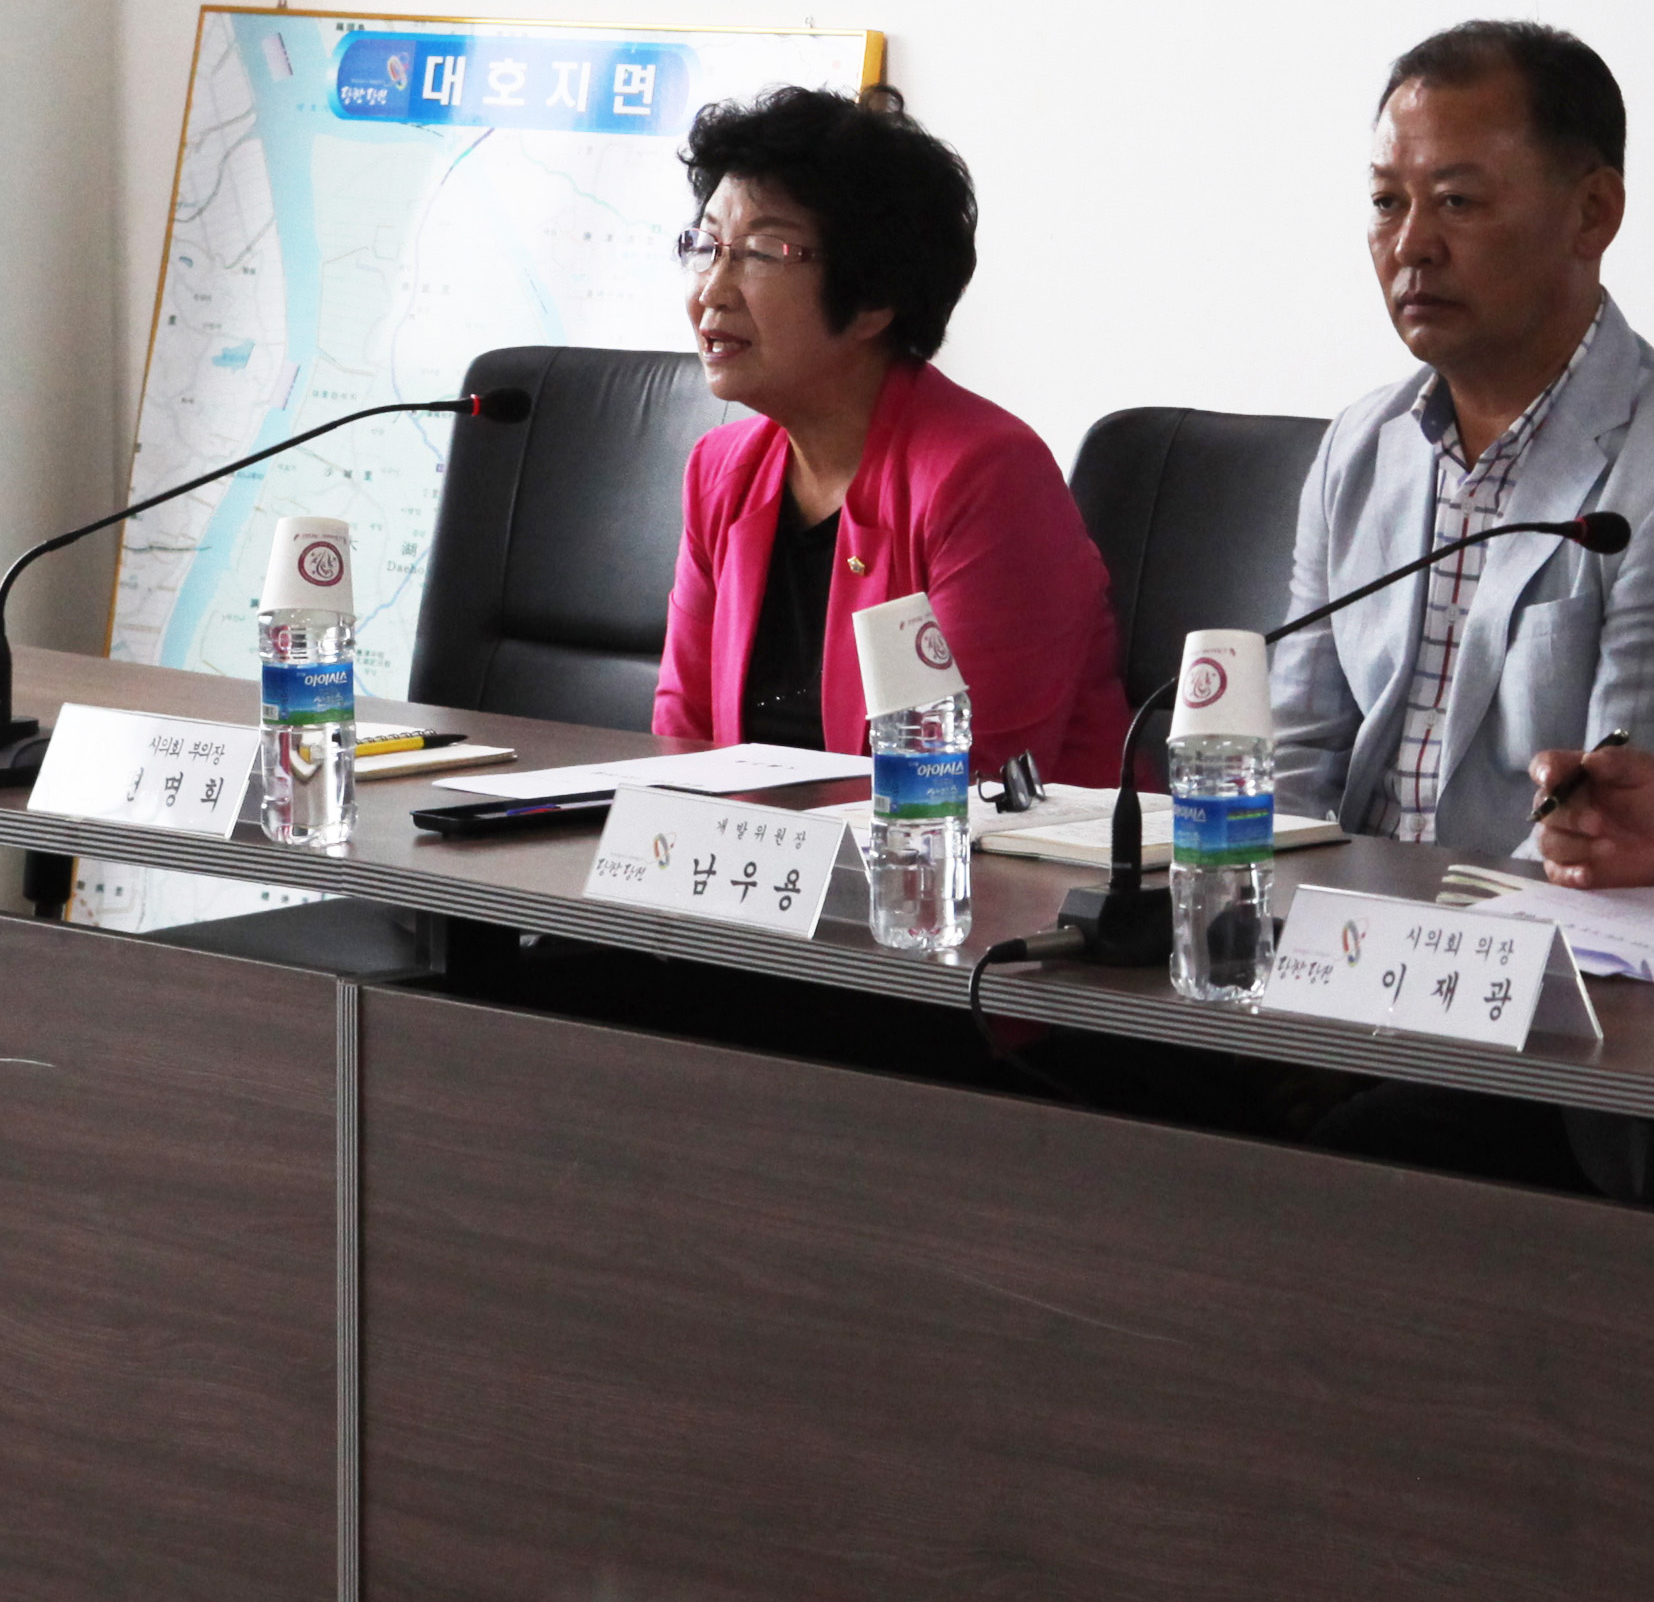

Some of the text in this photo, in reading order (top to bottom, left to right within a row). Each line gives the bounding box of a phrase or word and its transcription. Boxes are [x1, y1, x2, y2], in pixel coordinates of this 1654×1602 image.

[422, 54, 657, 116] 대호지면
[304, 670, 348, 688] 아이시스
[148, 734, 226, 766] 시의회 부의장
[917, 760, 965, 778] 아이시스
[692, 852, 802, 912] 남우용
[1405, 925, 1515, 966] 시의회 의장
[1381, 962, 1513, 1022] 이재광
